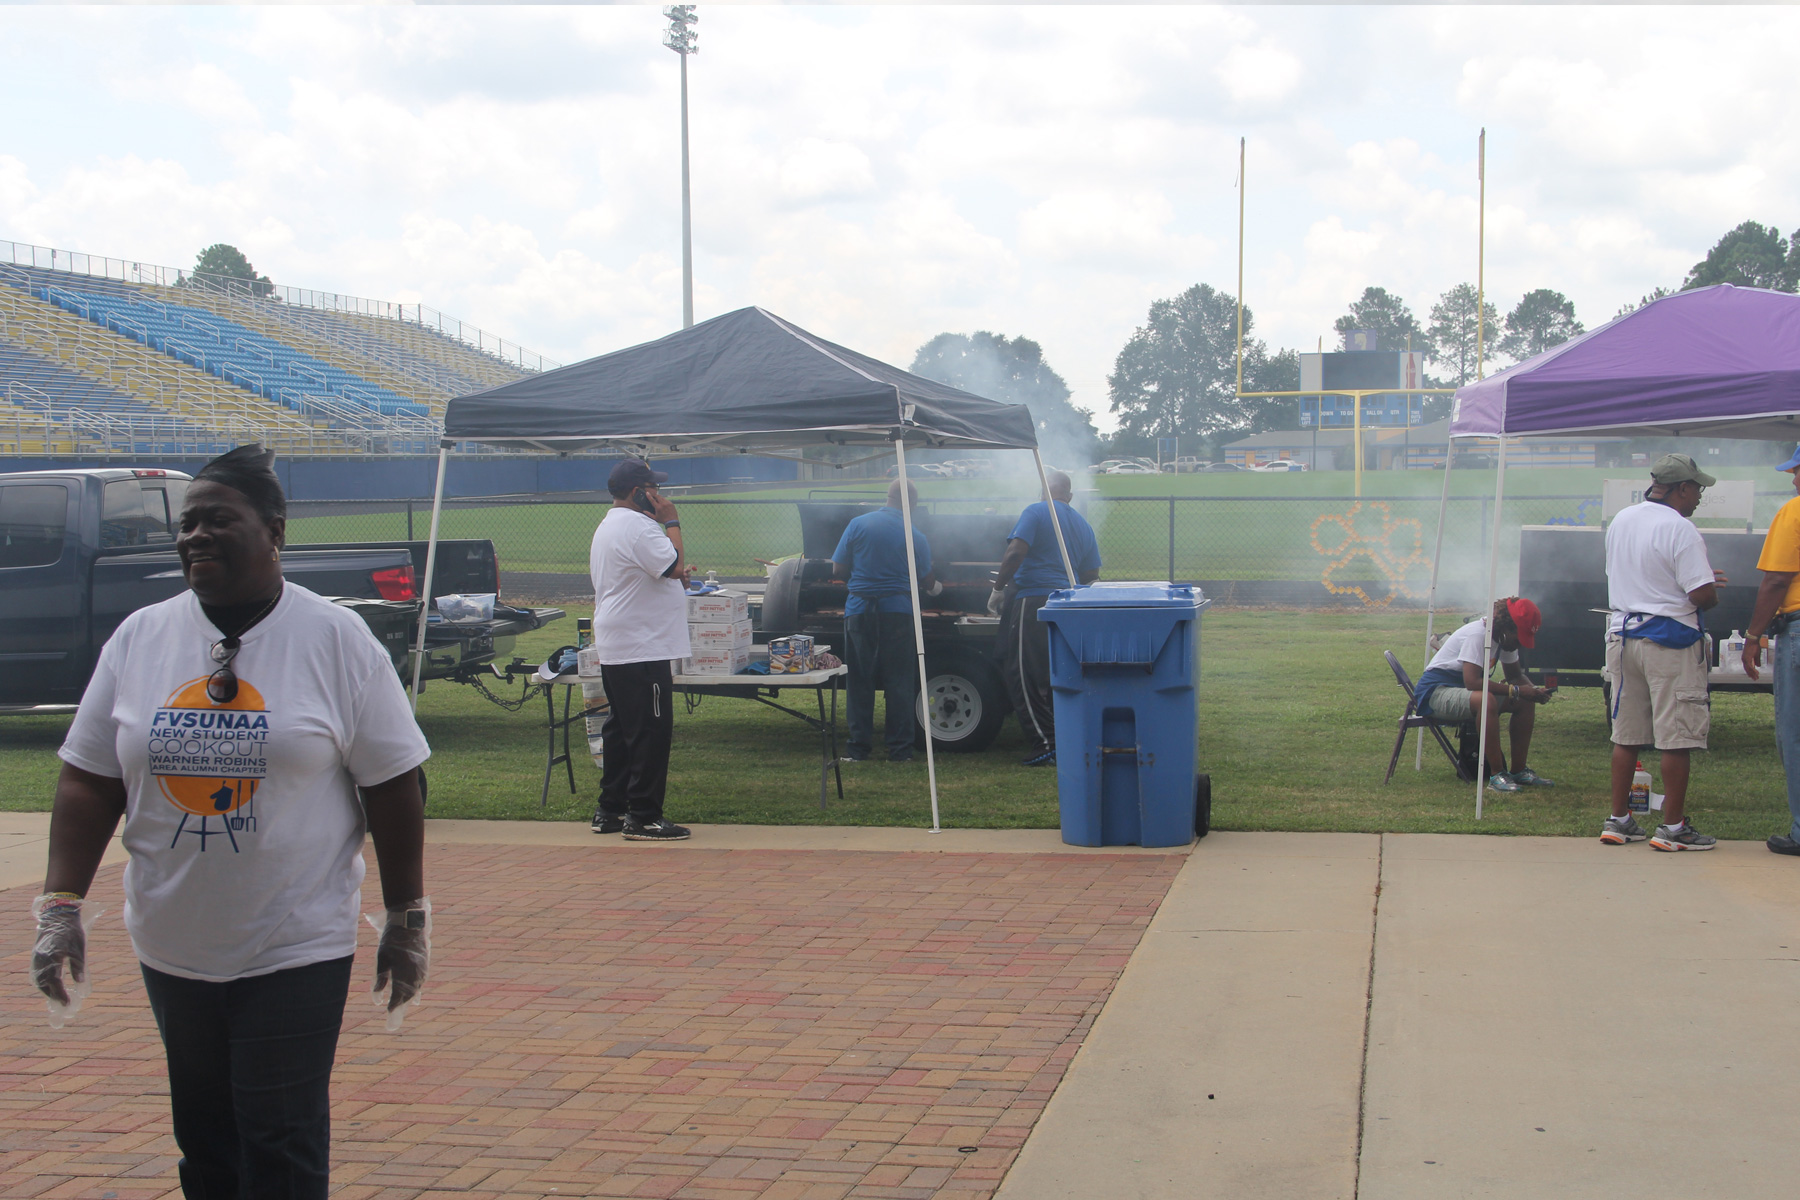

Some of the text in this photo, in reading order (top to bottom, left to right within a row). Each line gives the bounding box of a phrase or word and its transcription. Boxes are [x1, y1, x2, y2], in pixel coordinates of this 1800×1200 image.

[152, 711, 269, 730] FVSUNAA
[150, 728, 269, 741] NEW STUDENT
[148, 738, 269, 757] COOKOUT
[151, 755, 267, 767] WARNER ROBINS
[180, 765, 218, 773] ALUMNI
[220, 766, 267, 774] CHAPTER
